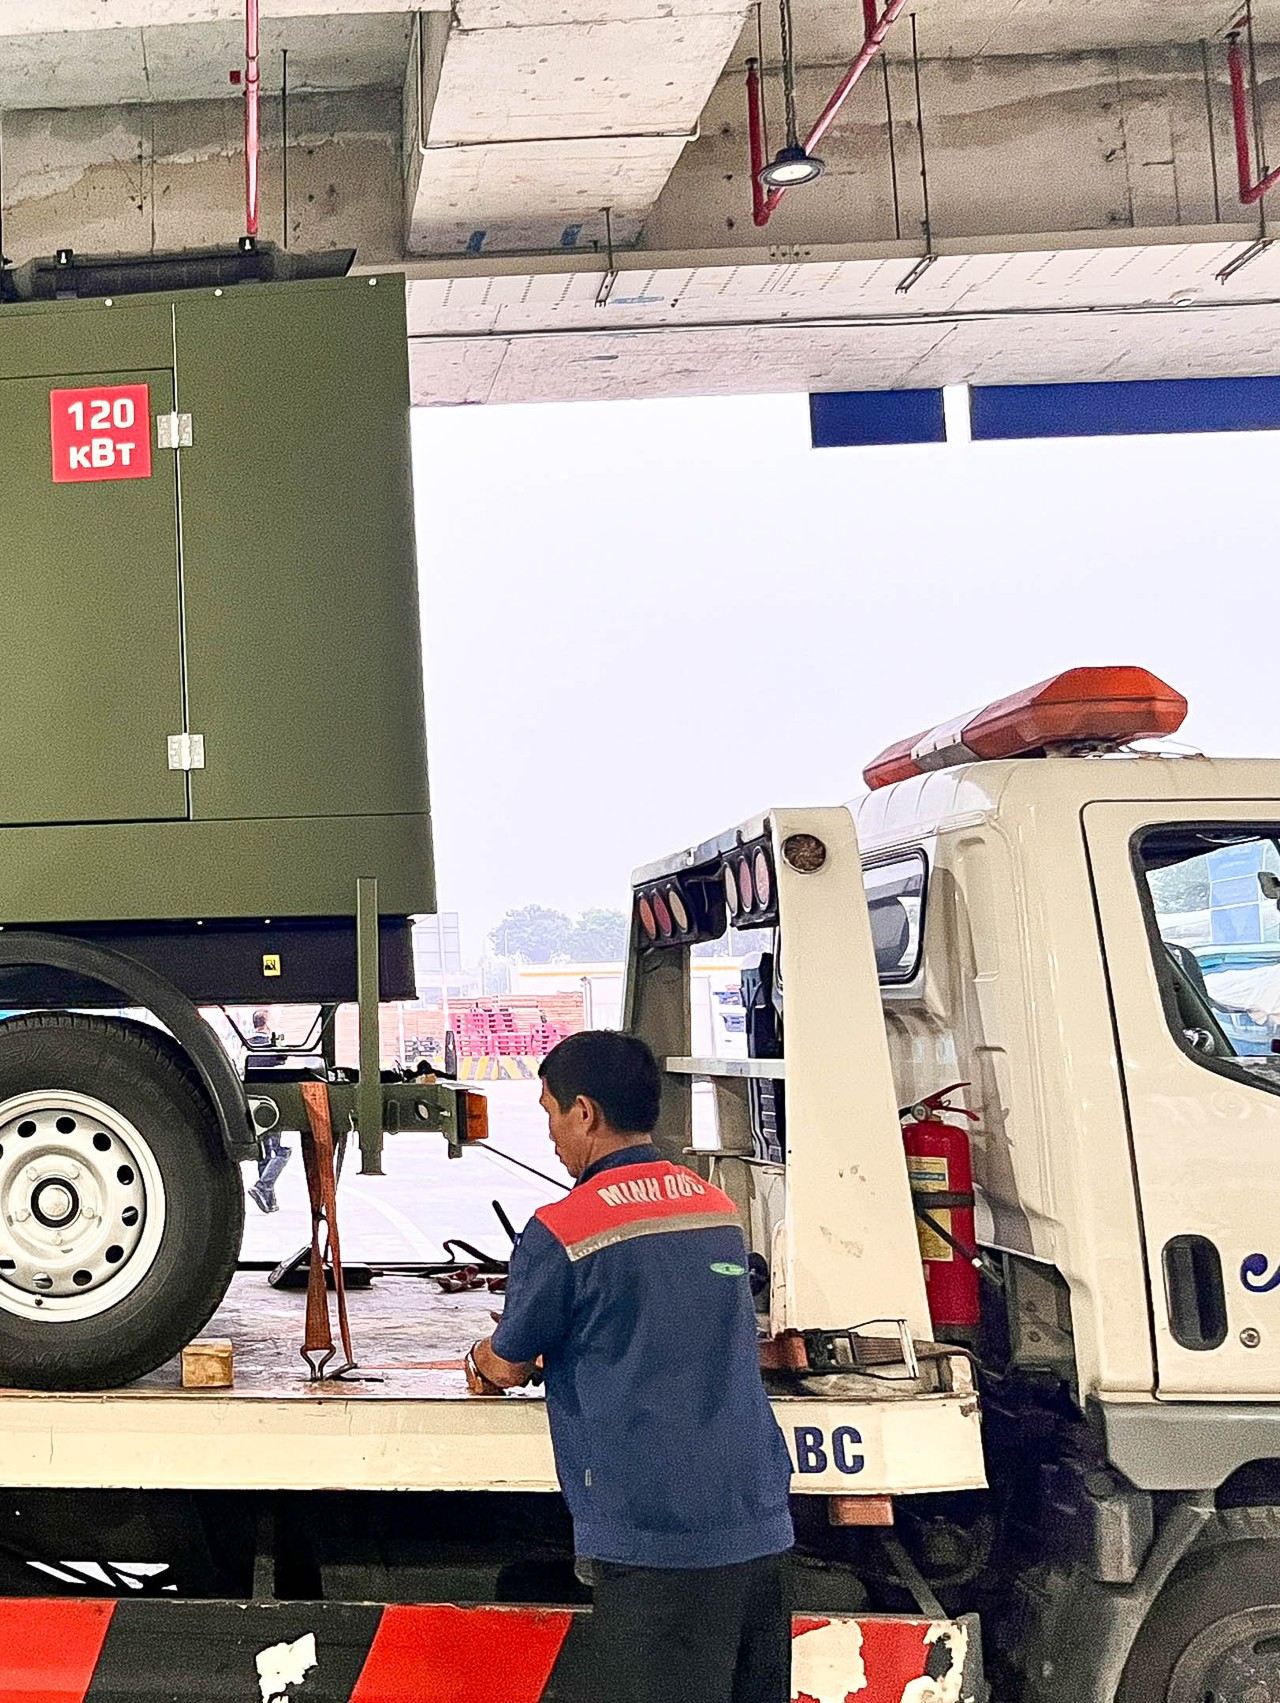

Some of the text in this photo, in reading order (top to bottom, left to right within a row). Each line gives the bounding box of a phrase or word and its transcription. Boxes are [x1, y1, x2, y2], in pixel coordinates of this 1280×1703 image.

[67, 398, 135, 431] 120
[69, 438, 136, 470] кВт
[596, 1177, 664, 1207] MINH
[780, 1425, 865, 1475] BC
